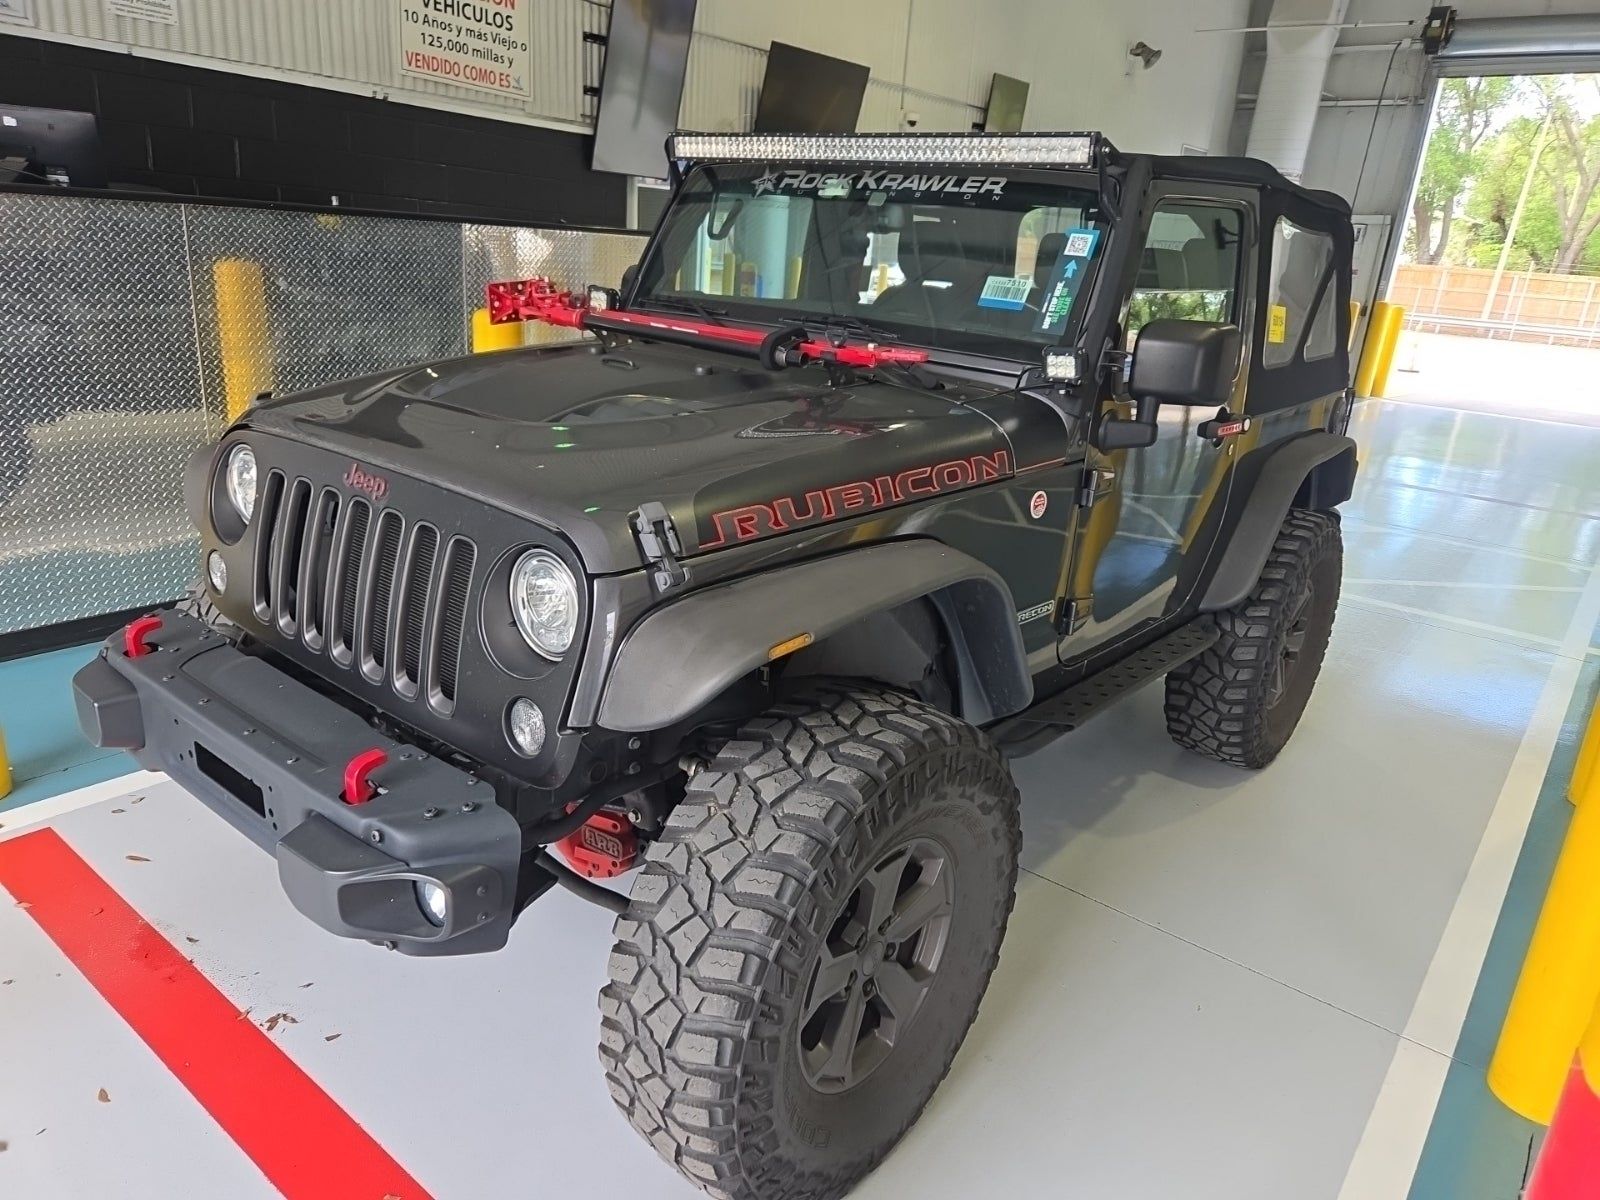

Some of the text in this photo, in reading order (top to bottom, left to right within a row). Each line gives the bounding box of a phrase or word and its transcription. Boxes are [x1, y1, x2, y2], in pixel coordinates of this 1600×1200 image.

[404, 9, 528, 52] 10 Años y más Viejo o
[420, 32, 514, 68] 125,000 millas y
[405, 50, 511, 88] VENDIDO COMO ES
[779, 169, 1008, 195] ROCK KRAWLER
[343, 463, 388, 501] Jeep
[700, 450, 1012, 548] RUBICON
[1018, 604, 1052, 621] RECON
[585, 829, 620, 858] ARB
